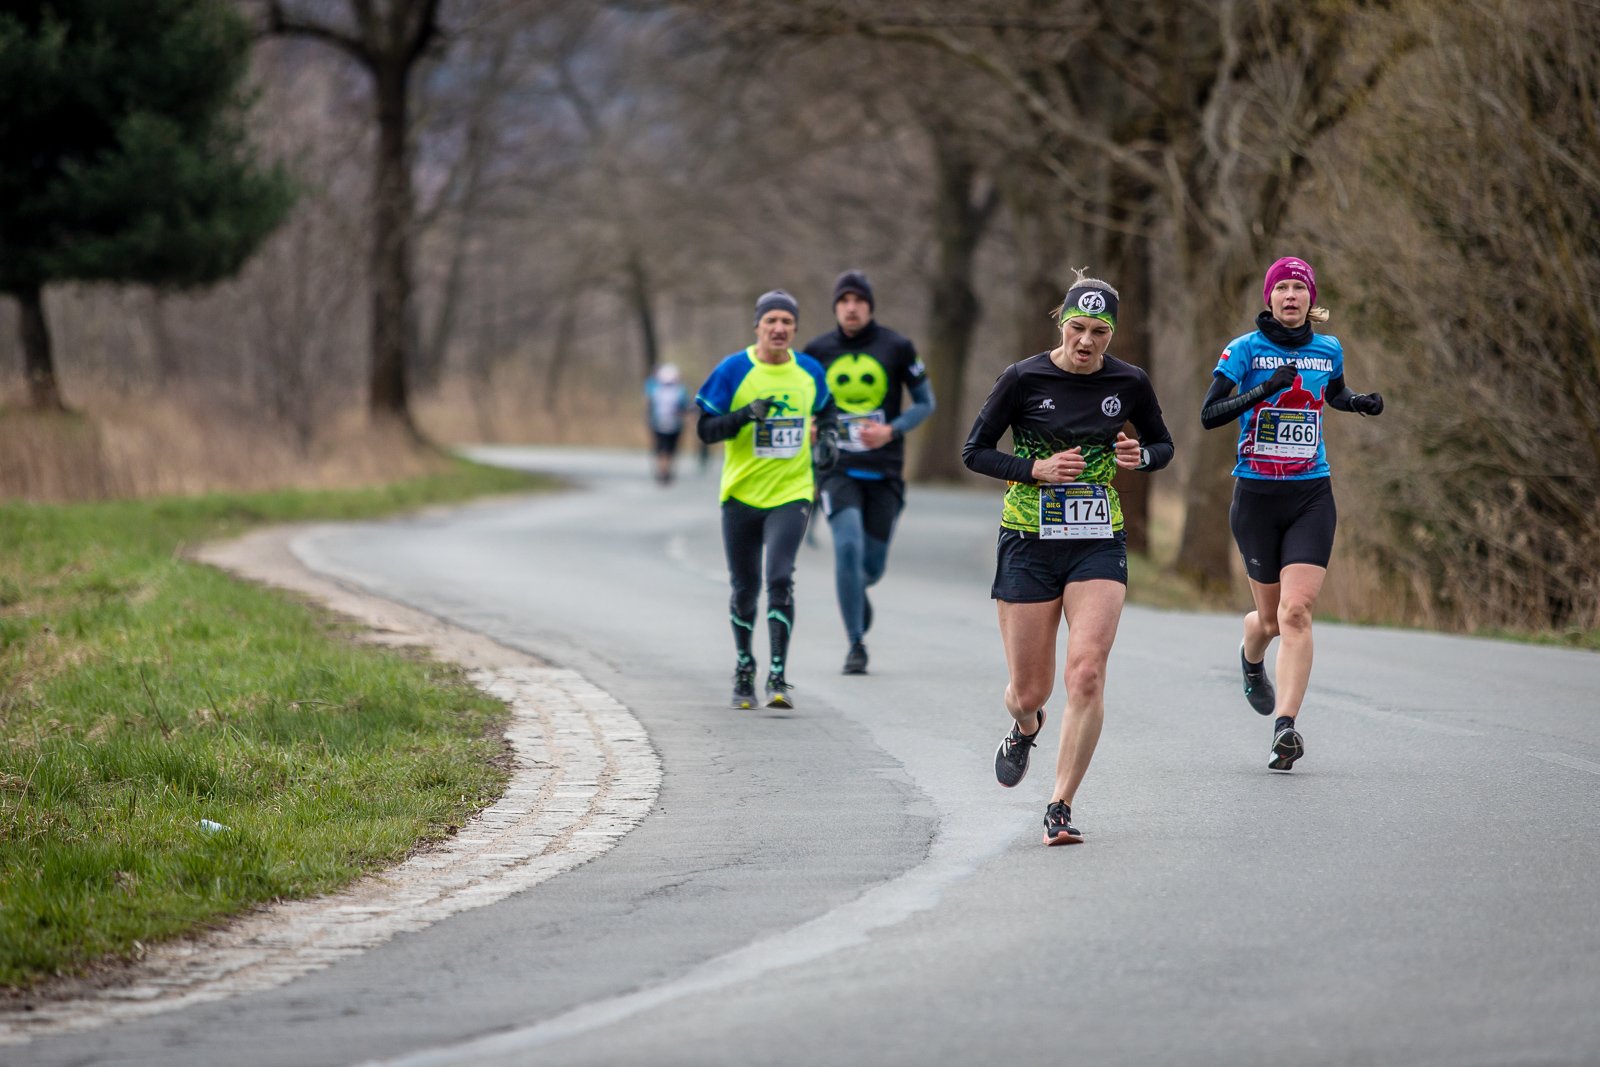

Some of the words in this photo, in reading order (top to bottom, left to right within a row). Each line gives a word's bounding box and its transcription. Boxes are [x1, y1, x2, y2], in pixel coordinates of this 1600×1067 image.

[1252, 356, 1285, 370] KASIA
[774, 430, 802, 446] 414
[1279, 423, 1314, 443] 466
[1069, 500, 1106, 521] 174
